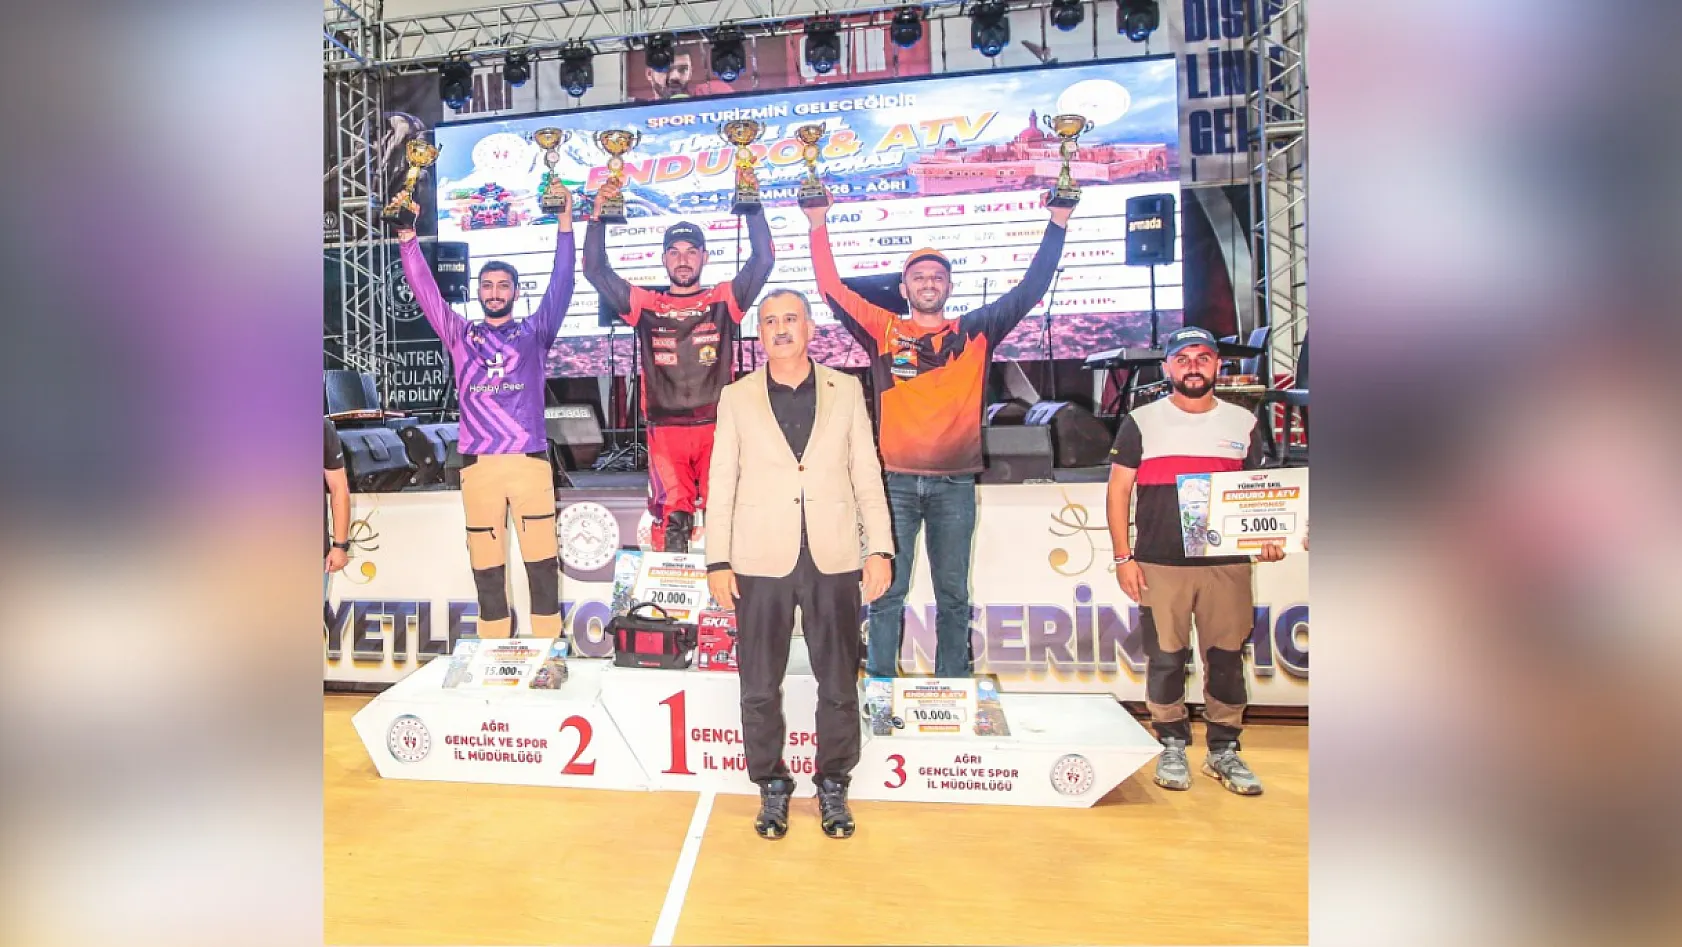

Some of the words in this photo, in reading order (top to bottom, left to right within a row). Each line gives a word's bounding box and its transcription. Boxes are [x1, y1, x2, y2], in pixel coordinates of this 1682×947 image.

[647, 115, 696, 128] SPOR
[699, 104, 788, 123] TURİZMİN
[793, 92, 918, 115] GELECEĞİDİR
[820, 130, 863, 158] &
[874, 111, 999, 152] ATV
[865, 178, 906, 193] AĞRI
[1129, 217, 1162, 232] armada
[437, 262, 465, 273] armada
[388, 350, 446, 367] ANTREN
[1240, 517, 1278, 532] 5.000
[651, 591, 686, 604] 20.000
[702, 617, 731, 628] SKIL
[485, 666, 518, 676] 15.000
[913, 709, 951, 720] 10.000
[481, 719, 509, 732] AĞRI
[659, 689, 697, 775] 1
[445, 734, 496, 747] GENÇLİK
[498, 737, 513, 748] VE
[516, 738, 548, 749] SPOR
[691, 728, 744, 745] GENÇL
[789, 732, 821, 746] SPO
[559, 714, 597, 776] 2
[454, 748, 465, 760] İL
[468, 749, 543, 764] MÜDÜRLÜĞÜ
[703, 752, 718, 770] İL
[954, 753, 982, 764] AĞRI
[884, 754, 907, 788] 3
[918, 766, 968, 778] GENÇLİK
[970, 768, 985, 778] VE
[988, 768, 1019, 778] SPOR
[927, 778, 938, 789] İL
[941, 779, 1013, 791] MÜDÜRLÜĞÜ
